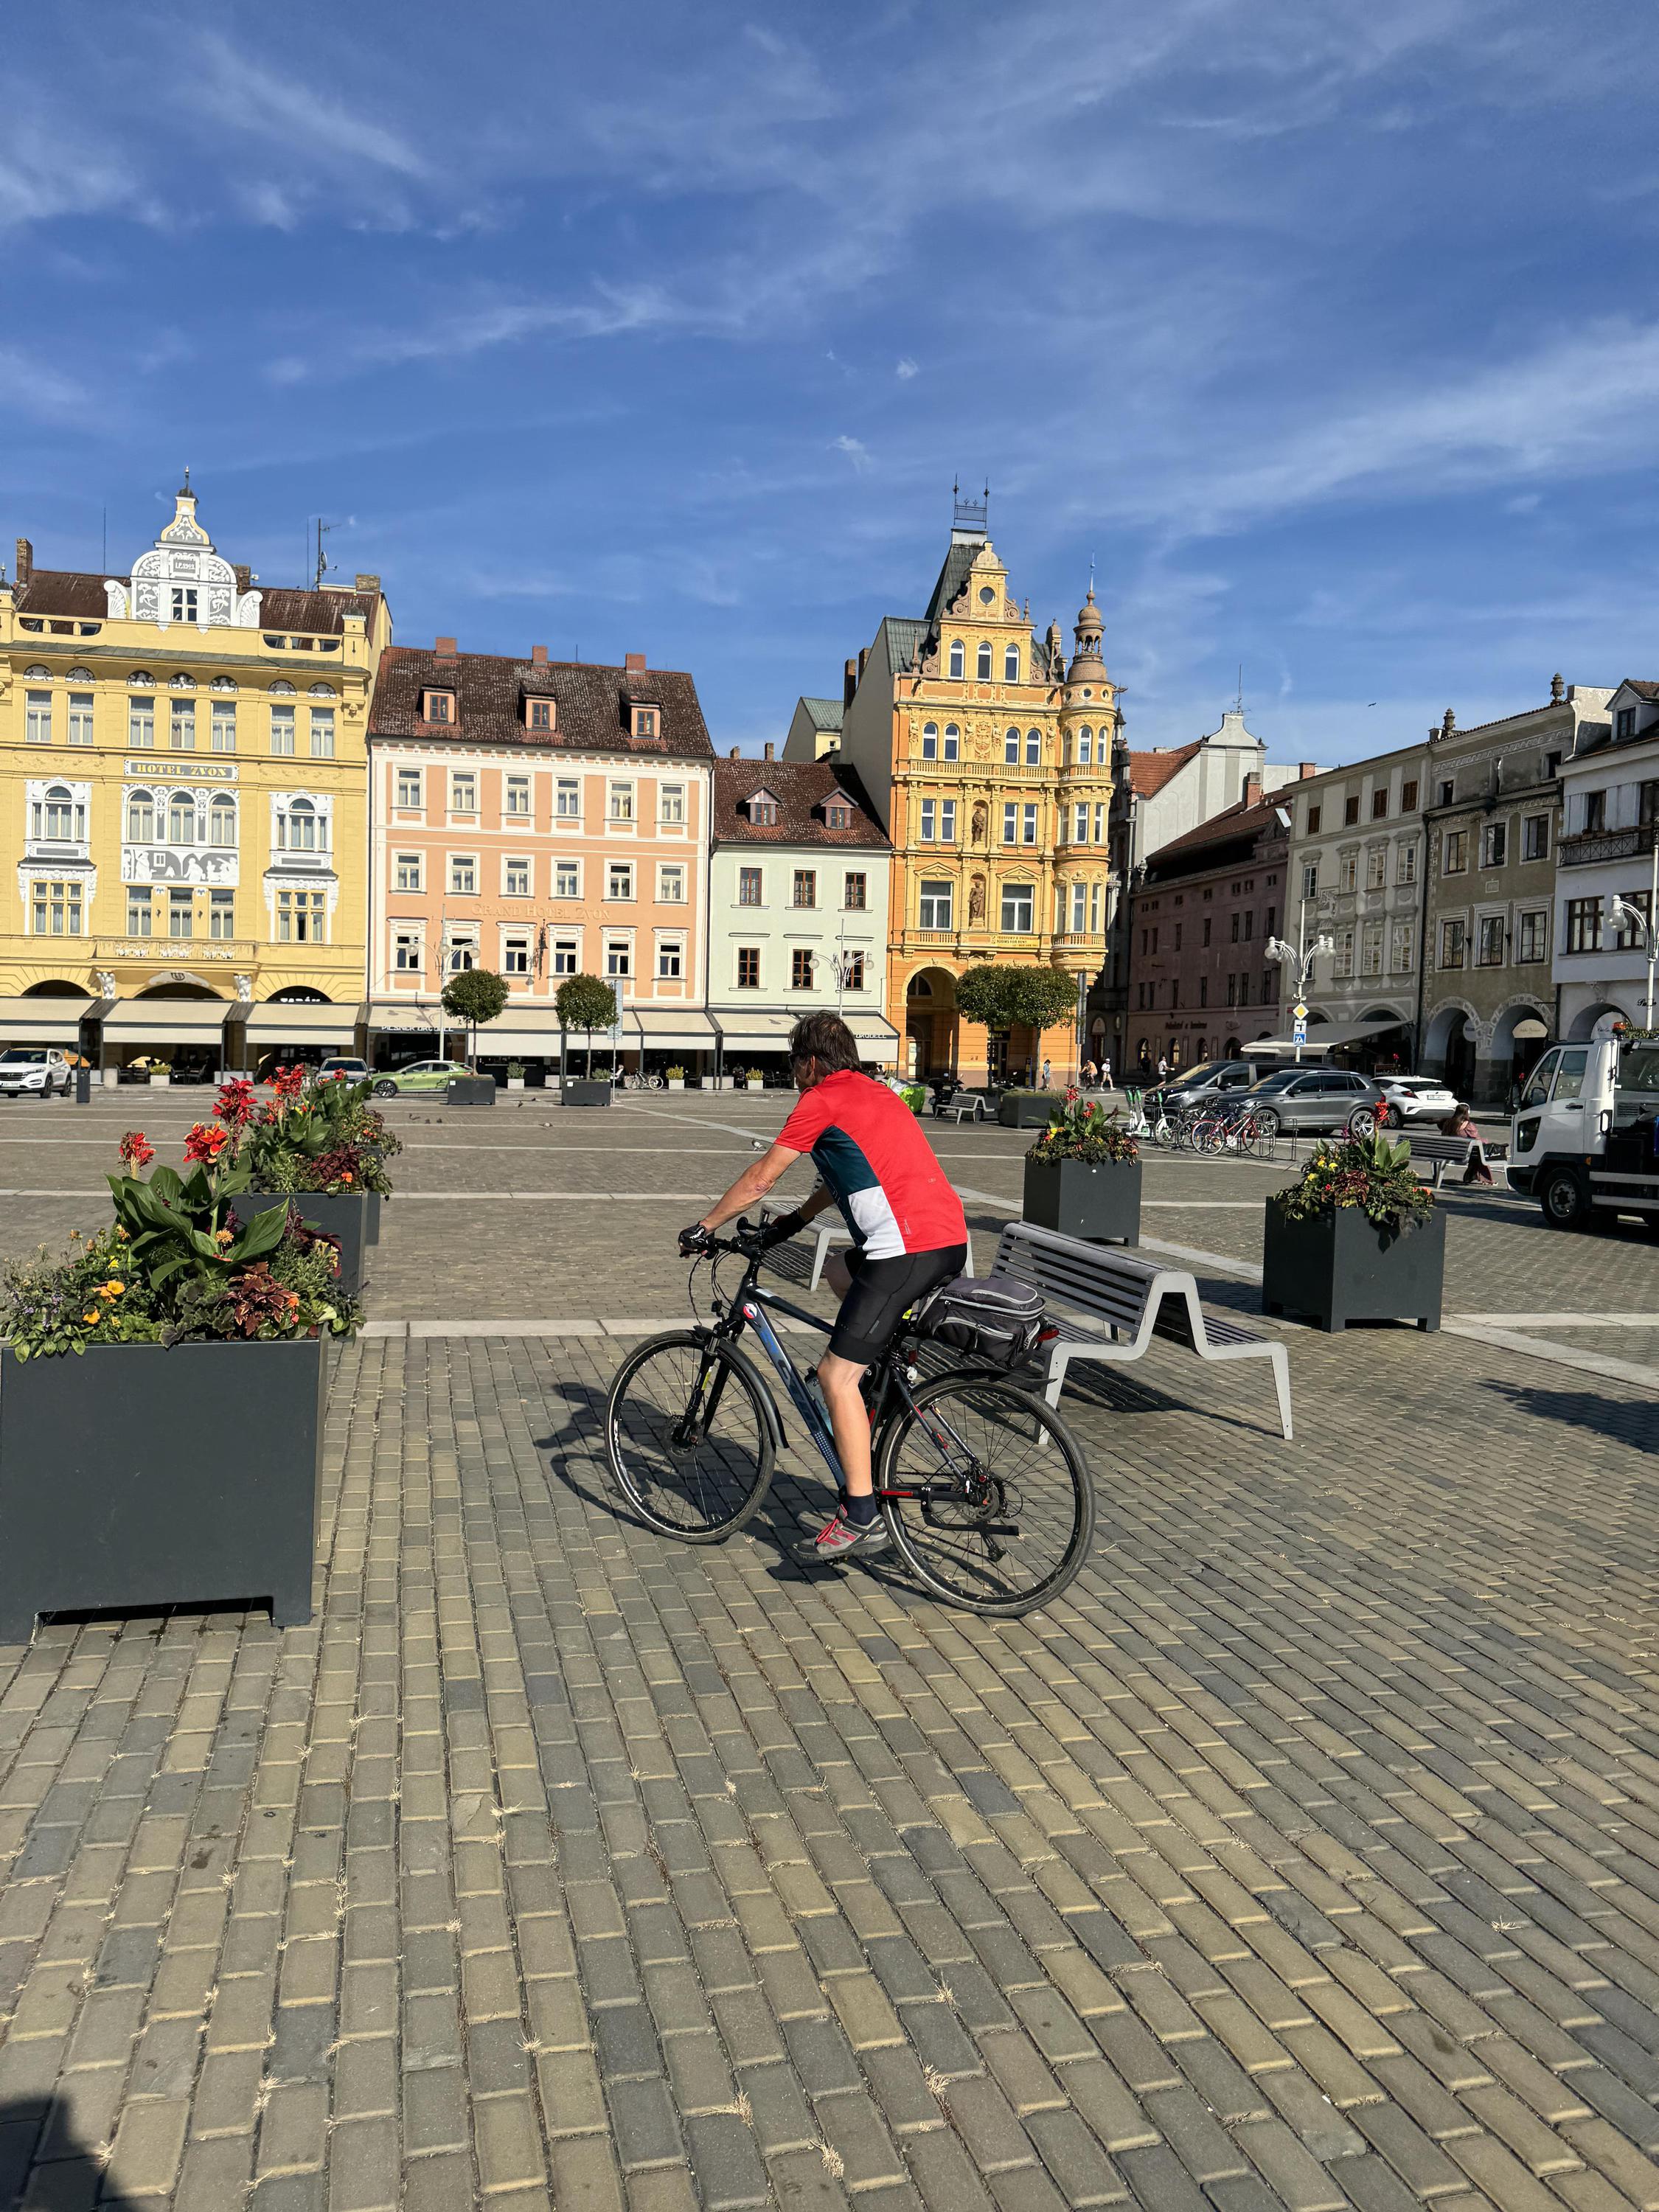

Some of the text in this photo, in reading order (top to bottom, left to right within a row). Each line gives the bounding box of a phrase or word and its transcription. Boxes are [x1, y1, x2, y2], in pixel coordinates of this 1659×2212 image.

[136, 764, 226, 776] HOTEL ZVON
[471, 903, 610, 920] GRAND HOTEL ZVON
